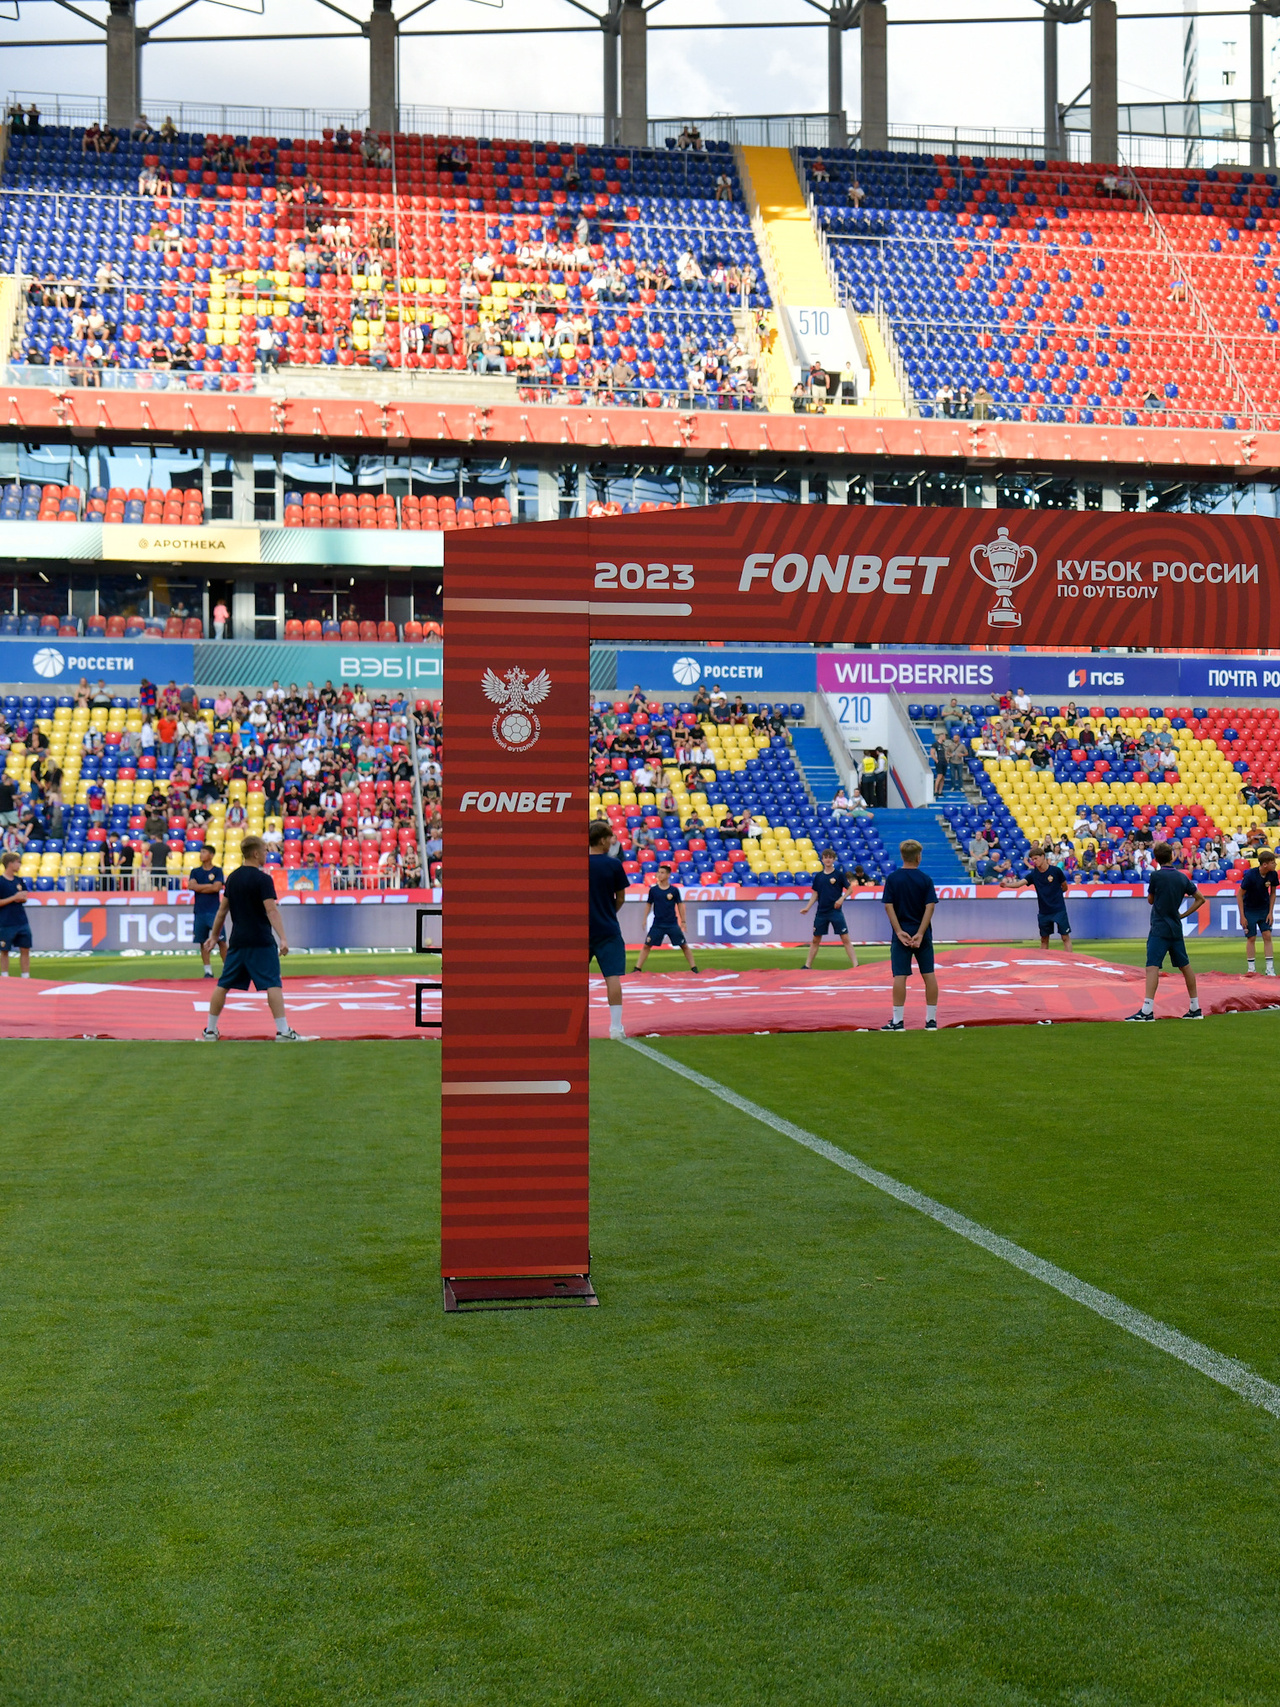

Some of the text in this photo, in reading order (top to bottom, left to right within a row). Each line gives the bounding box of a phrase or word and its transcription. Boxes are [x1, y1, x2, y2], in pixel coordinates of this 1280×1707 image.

[800, 310, 830, 336] 510
[153, 538, 226, 550] APOTHEKA
[594, 562, 695, 591] 2023
[738, 553, 950, 595] FONBET
[1056, 559, 1259, 584] КУБОК РОССИИ
[1057, 584, 1158, 599] ПО ФУТБОЛУ
[68, 656, 134, 671] РОССЕТИ
[704, 665, 763, 678] РОССЕТИ
[834, 662, 994, 685] WILDBERRIES
[1090, 672, 1125, 686] ПСБ
[1208, 669, 1258, 688] ПОЧТА
[838, 696, 871, 723] 210
[459, 791, 572, 813] FONBET
[697, 908, 773, 937] ПСБ
